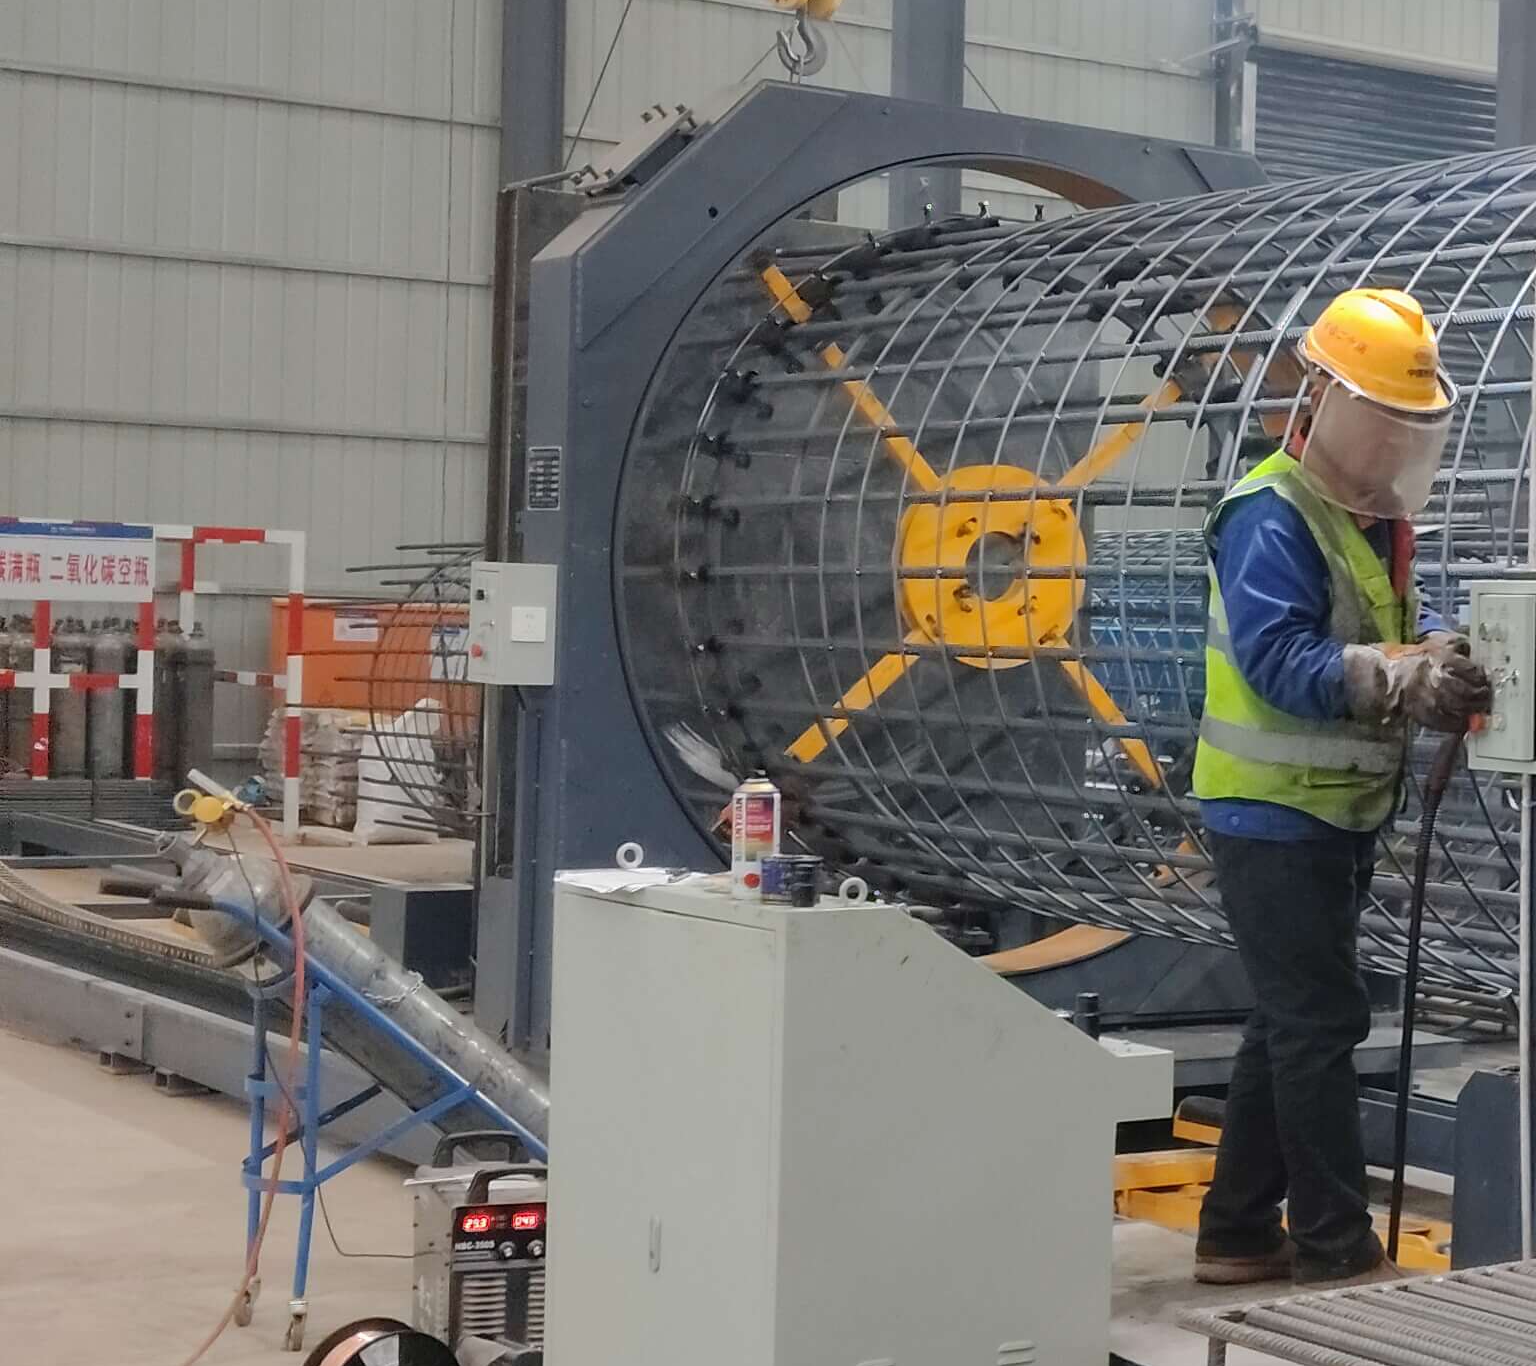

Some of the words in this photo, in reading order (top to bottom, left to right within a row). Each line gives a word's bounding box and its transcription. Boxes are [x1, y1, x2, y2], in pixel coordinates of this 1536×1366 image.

[50, 552, 149, 586] 二氧化碳空瓶
